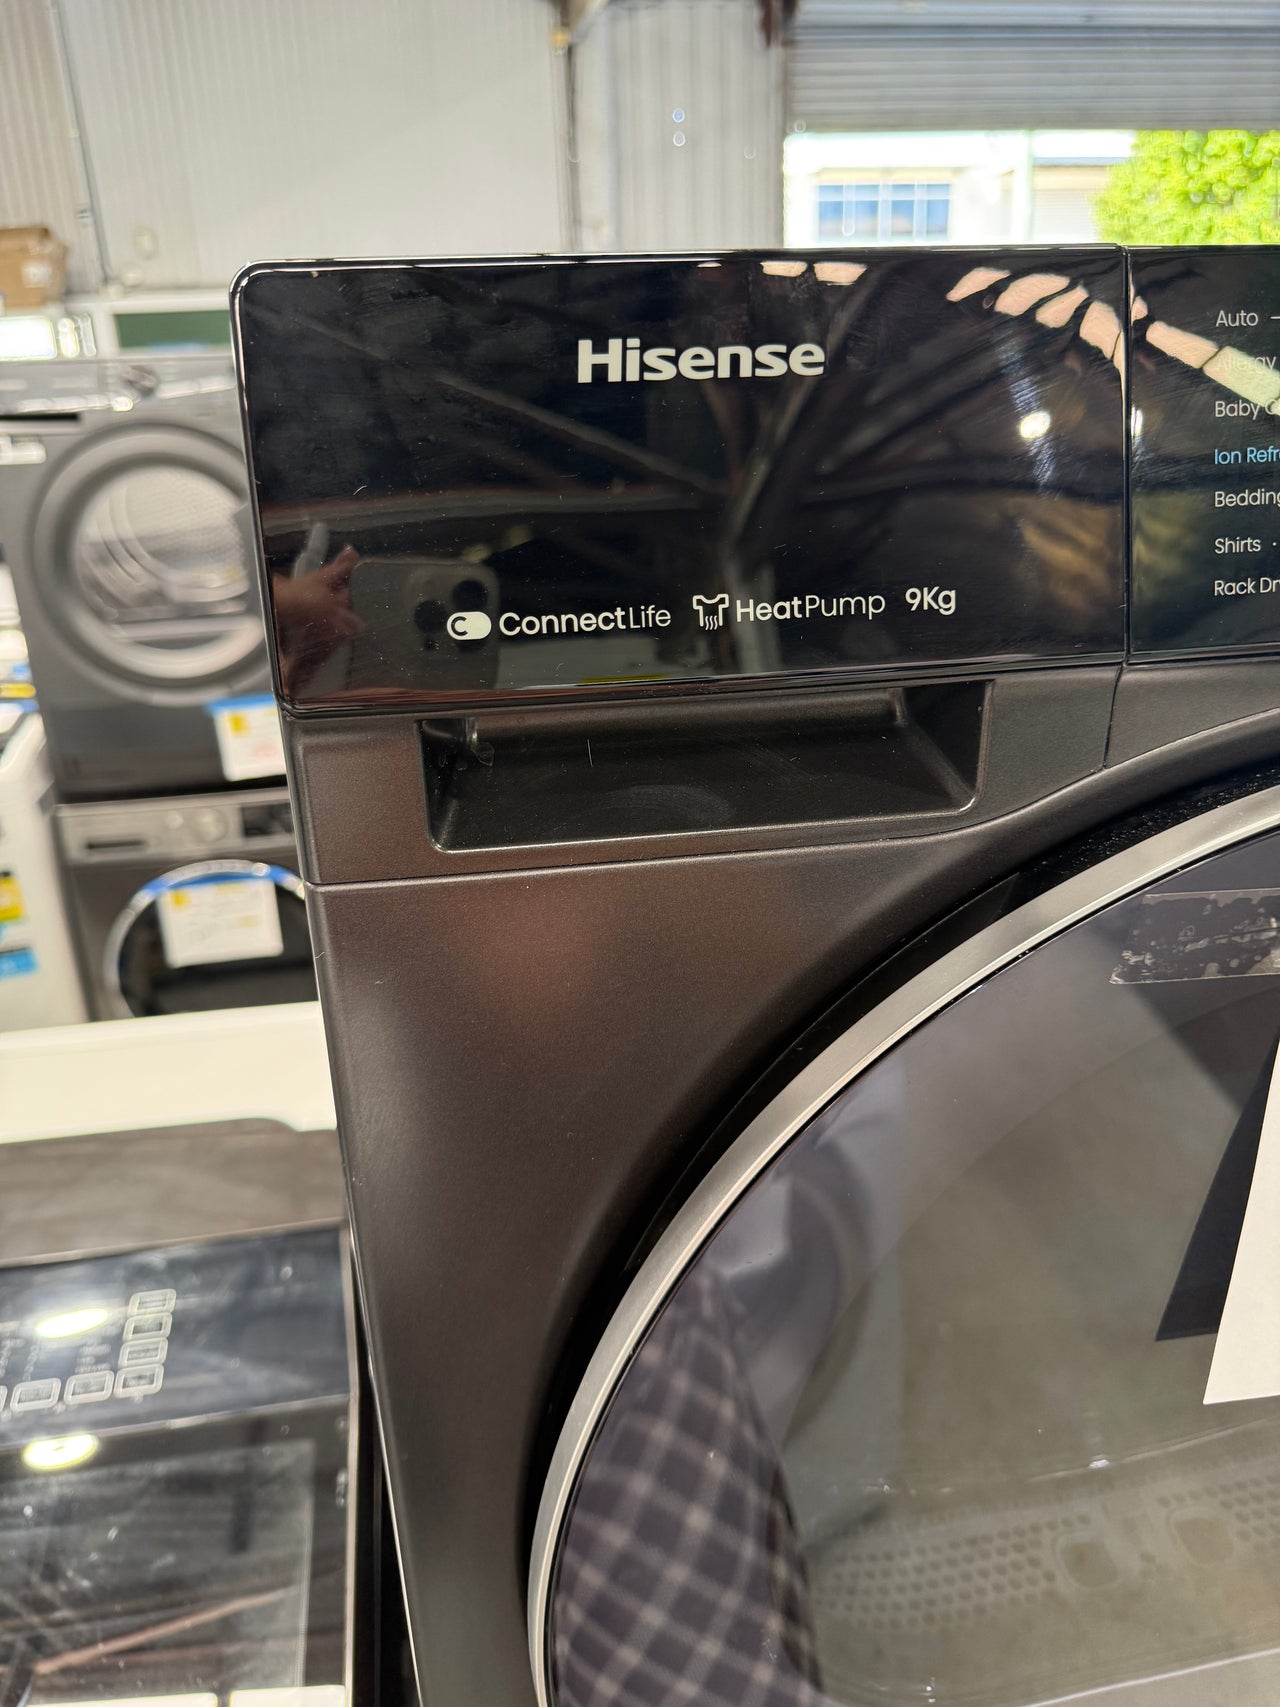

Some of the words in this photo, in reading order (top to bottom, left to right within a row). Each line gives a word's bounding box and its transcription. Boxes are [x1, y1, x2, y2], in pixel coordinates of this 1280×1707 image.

[1215, 310, 1259, 327] Auto
[577, 338, 825, 384] Hisense
[1214, 400, 1260, 420] Baby
[1214, 449, 1242, 465] Ion
[1246, 445, 1280, 464] Refr
[1214, 537, 1262, 554] Shirts
[1214, 577, 1256, 596] Rack
[1260, 577, 1280, 594] Dr
[735, 594, 886, 623] HeatPump
[905, 586, 957, 616] 9Kg
[498, 605, 672, 637] ConnectLife
